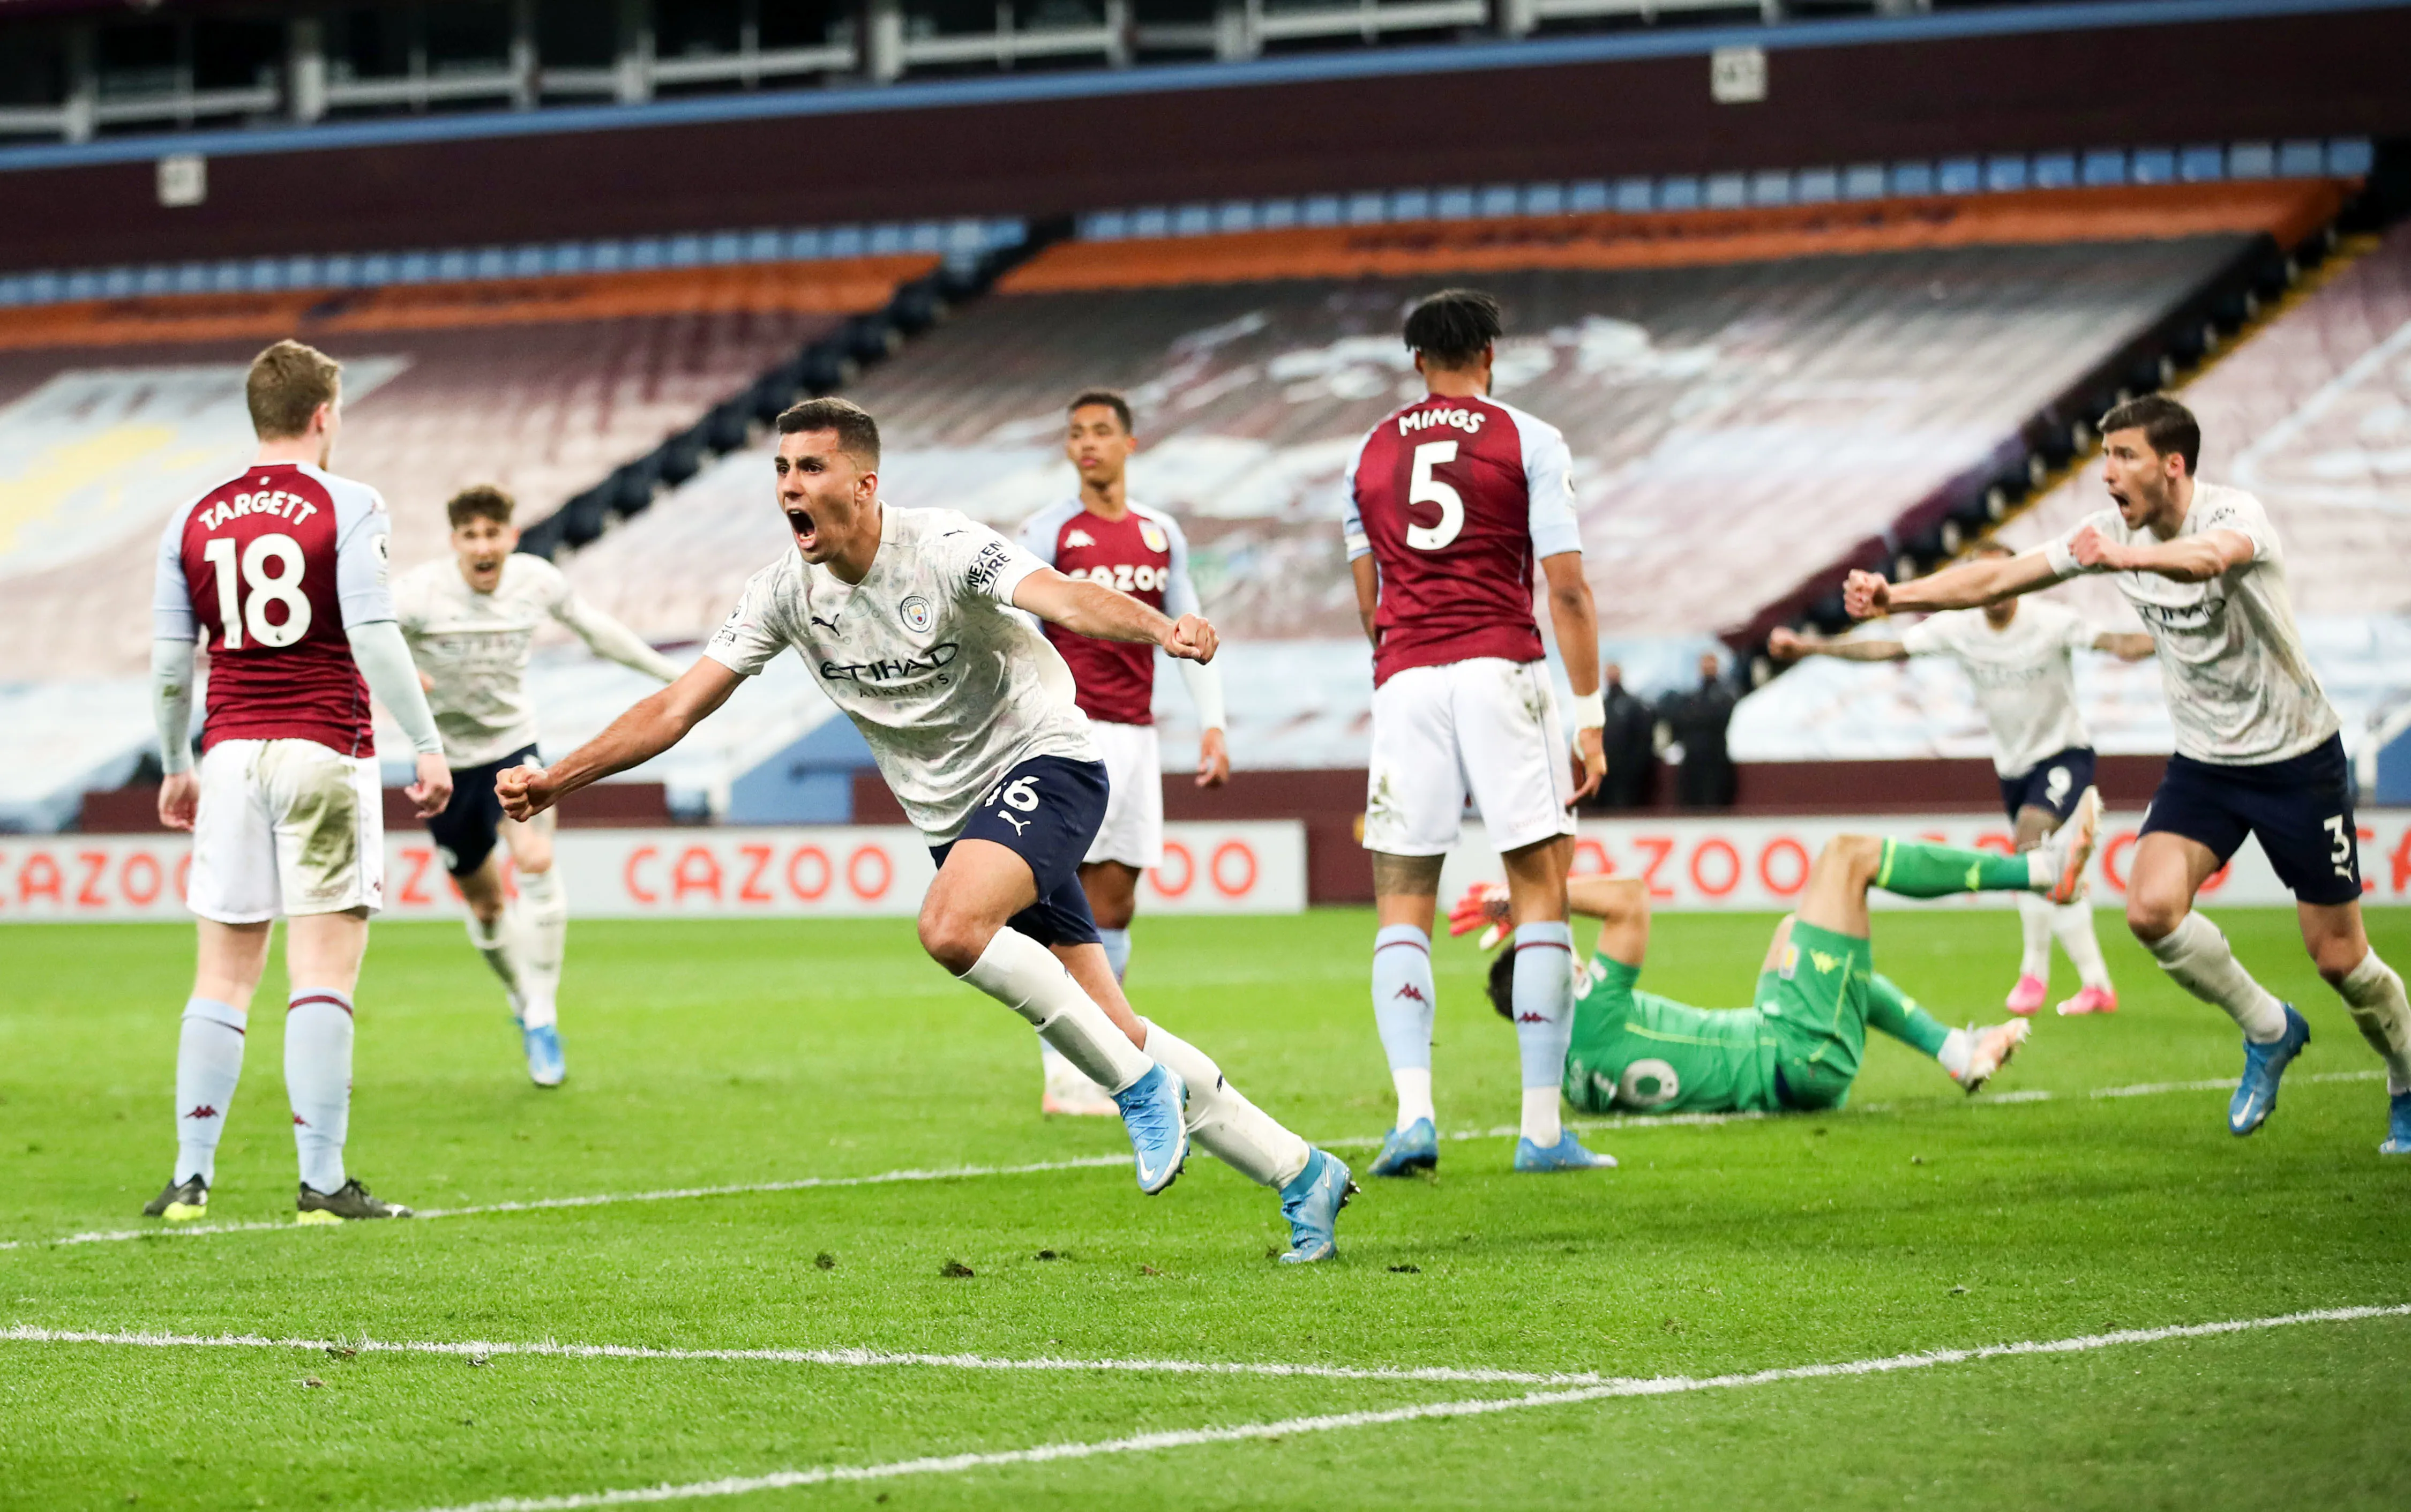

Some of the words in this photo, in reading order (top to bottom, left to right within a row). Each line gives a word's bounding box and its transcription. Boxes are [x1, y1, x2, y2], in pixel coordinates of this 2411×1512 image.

[1398, 408, 1486, 437] MINGS
[198, 490, 317, 531] TARGETT
[1406, 439, 1465, 551] 5
[967, 540, 1004, 587] NEXEN
[980, 552, 1012, 585] TIRE
[204, 533, 312, 649] 18
[820, 642, 960, 682] ETIHAD
[859, 673, 949, 698] AIRWAYS
[2324, 814, 2350, 864] 3
[624, 844, 894, 903] CAZOO
